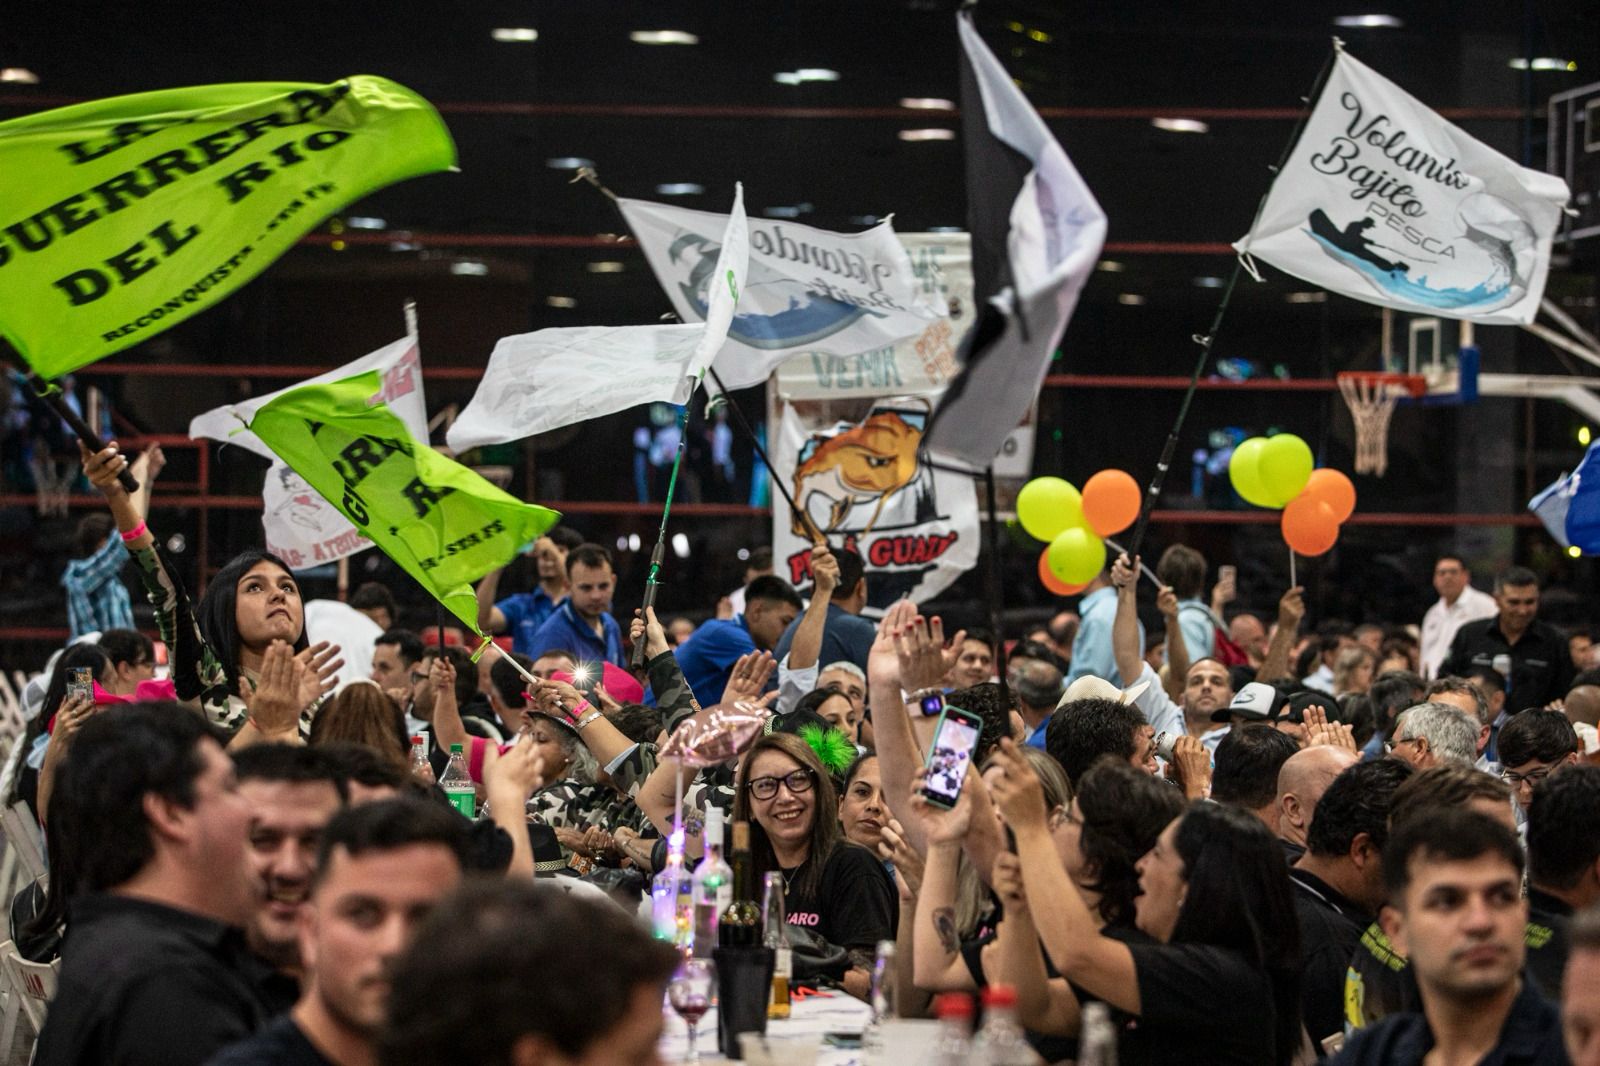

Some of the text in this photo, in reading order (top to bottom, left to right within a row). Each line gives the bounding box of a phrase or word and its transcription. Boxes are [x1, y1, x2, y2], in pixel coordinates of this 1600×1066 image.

[0, 85, 351, 268] UERRERA
[53, 130, 354, 307] DEL RIO
[1310, 136, 1428, 218] Bajito
[1365, 200, 1457, 260] PESCA
